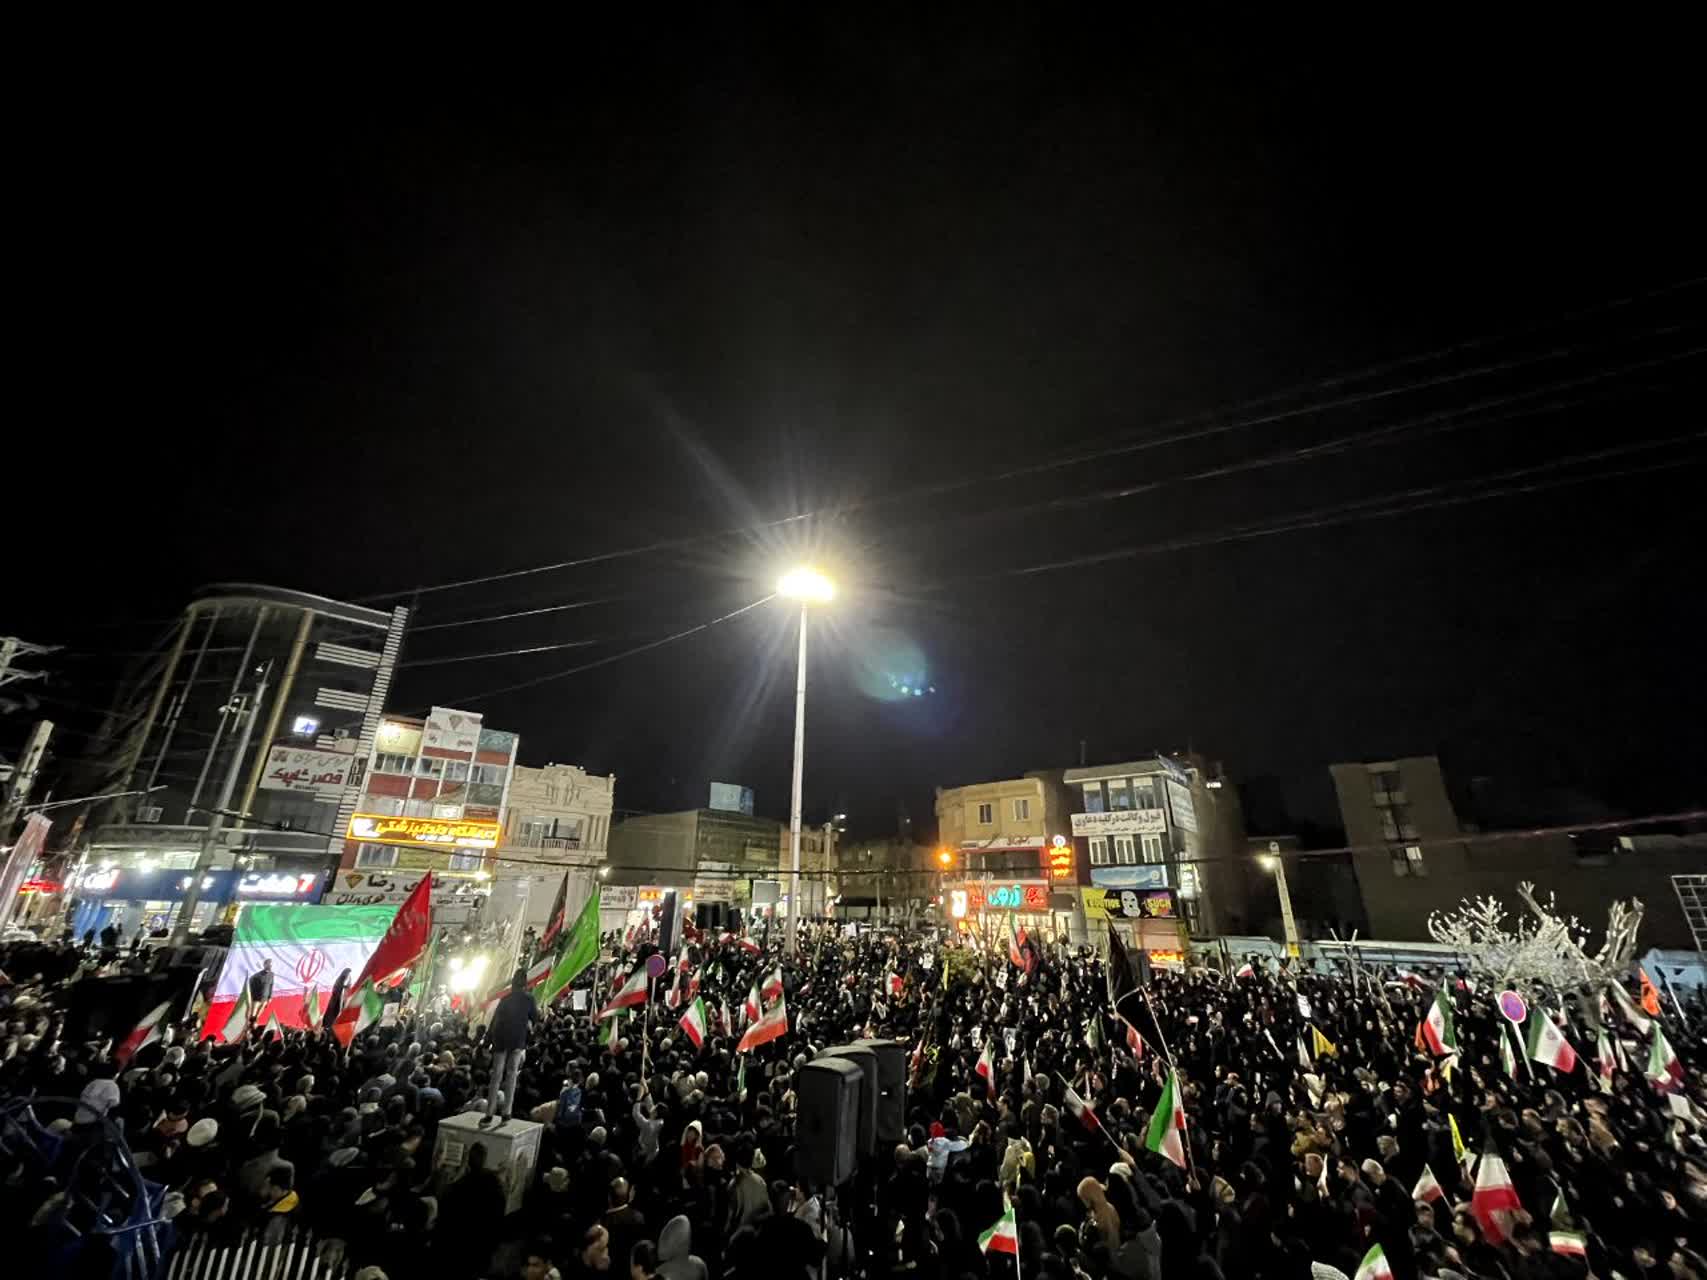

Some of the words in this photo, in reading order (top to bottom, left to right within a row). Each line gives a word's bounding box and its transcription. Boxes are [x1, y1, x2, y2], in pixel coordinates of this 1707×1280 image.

[310, 769, 344, 785] قصر
[1121, 812, 1142, 824] وکالت
[375, 820, 448, 837] دندانپزشکی
[367, 874, 395, 892] رضا
